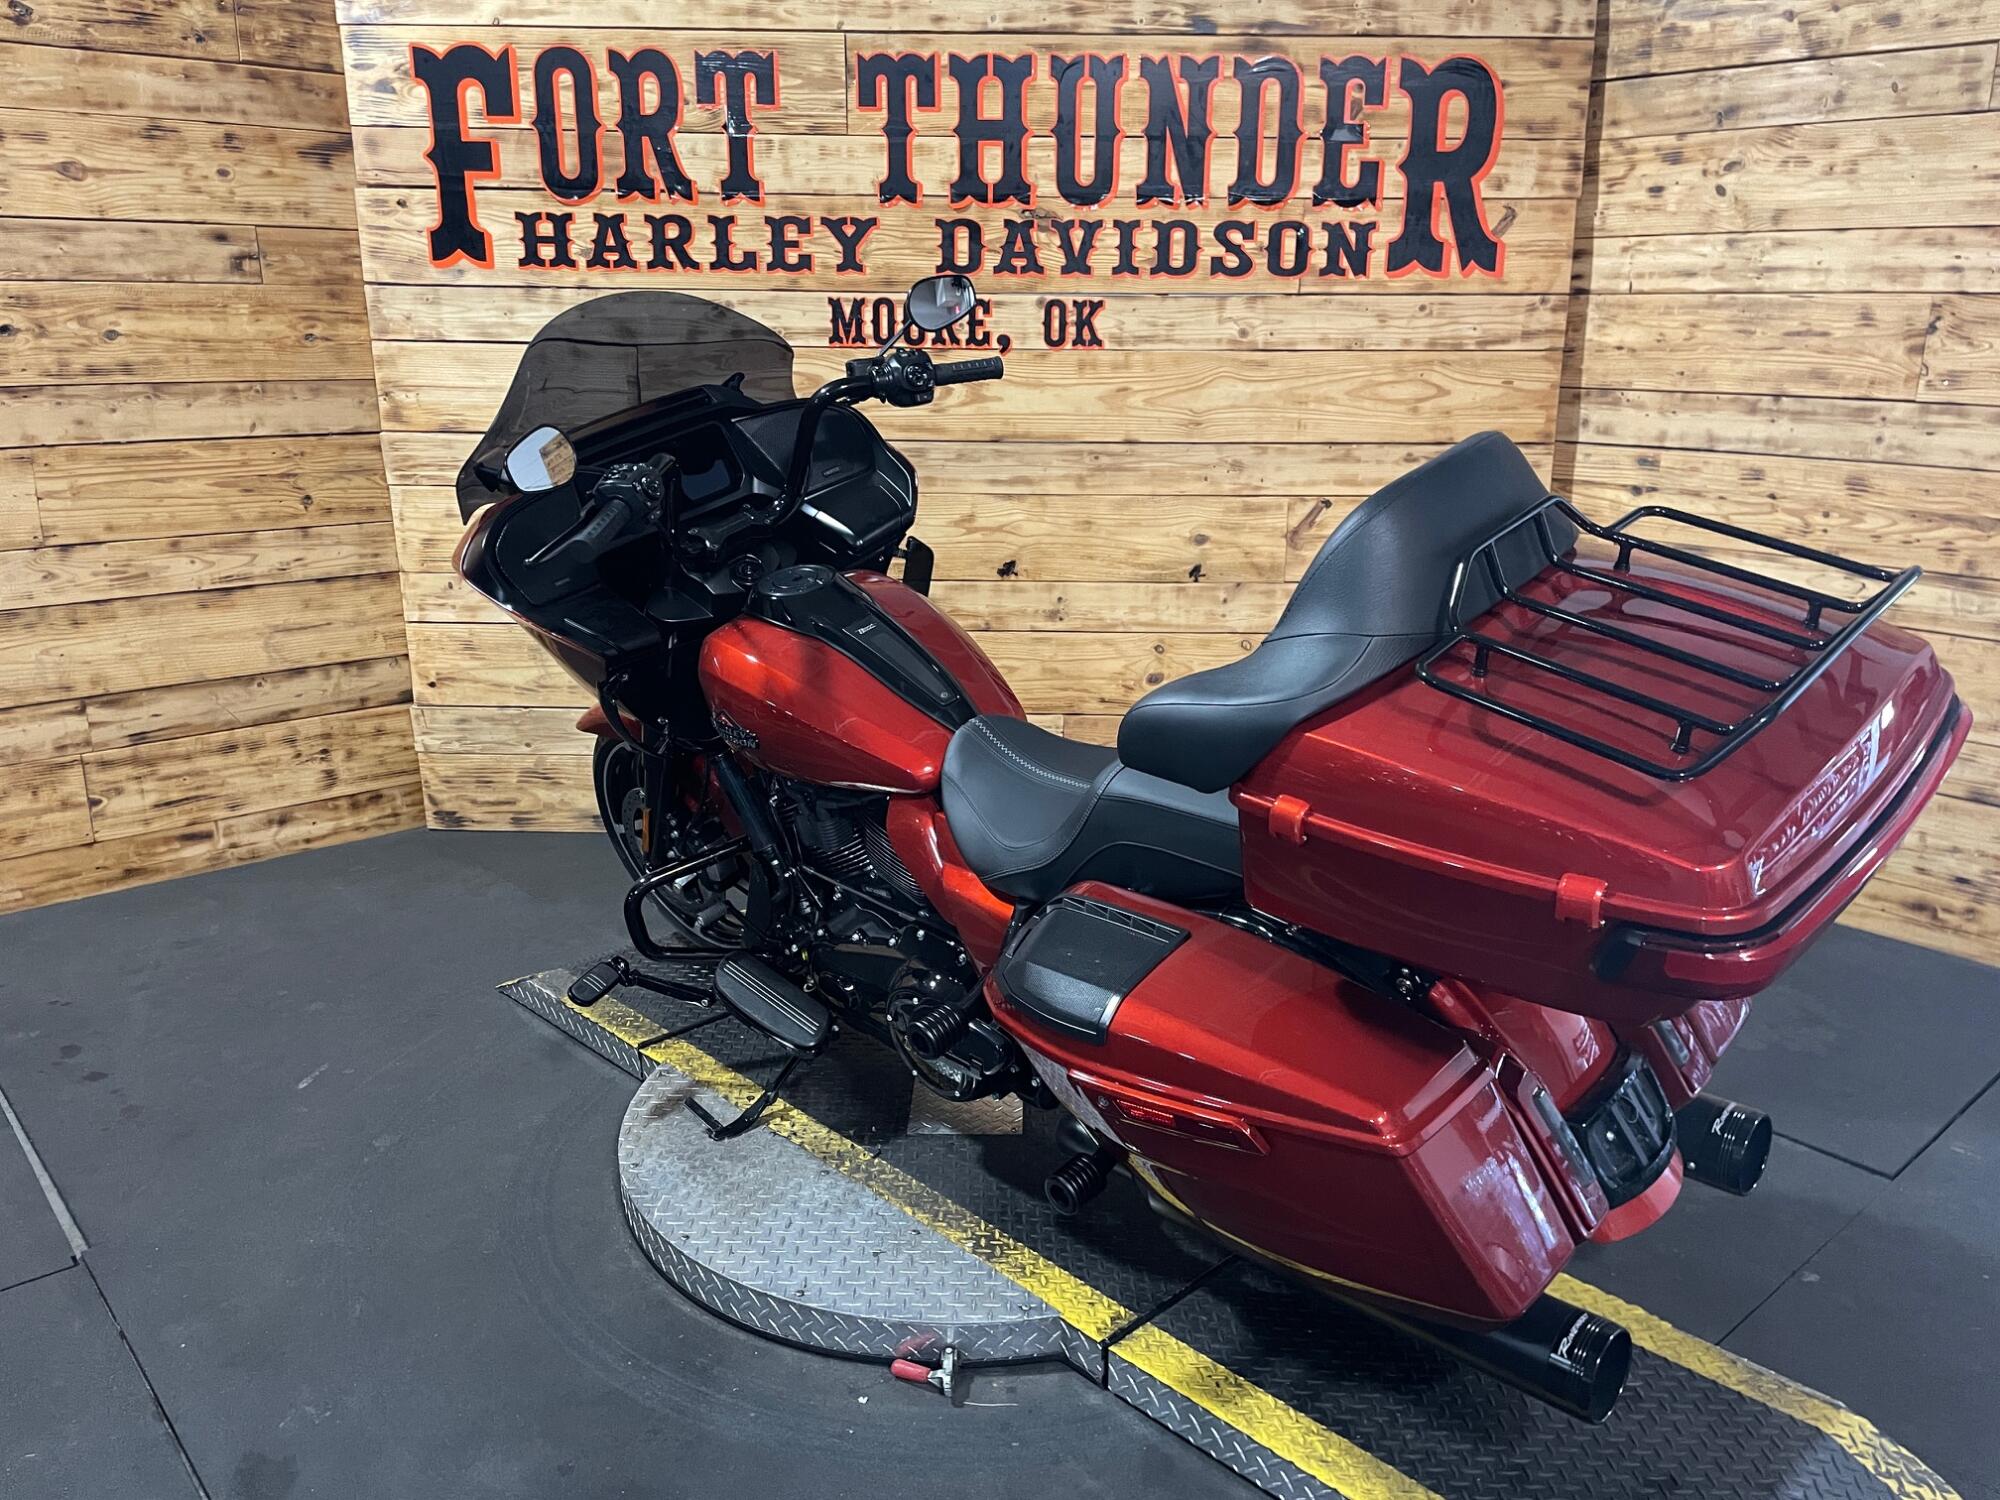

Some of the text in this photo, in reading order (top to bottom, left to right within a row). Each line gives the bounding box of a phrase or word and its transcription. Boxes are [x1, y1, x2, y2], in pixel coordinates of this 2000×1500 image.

[409, 41, 1505, 279] FORT THUNDER
[514, 211, 1379, 280] HARLEY DAVIDSON
[1042, 298, 1107, 348] OK
